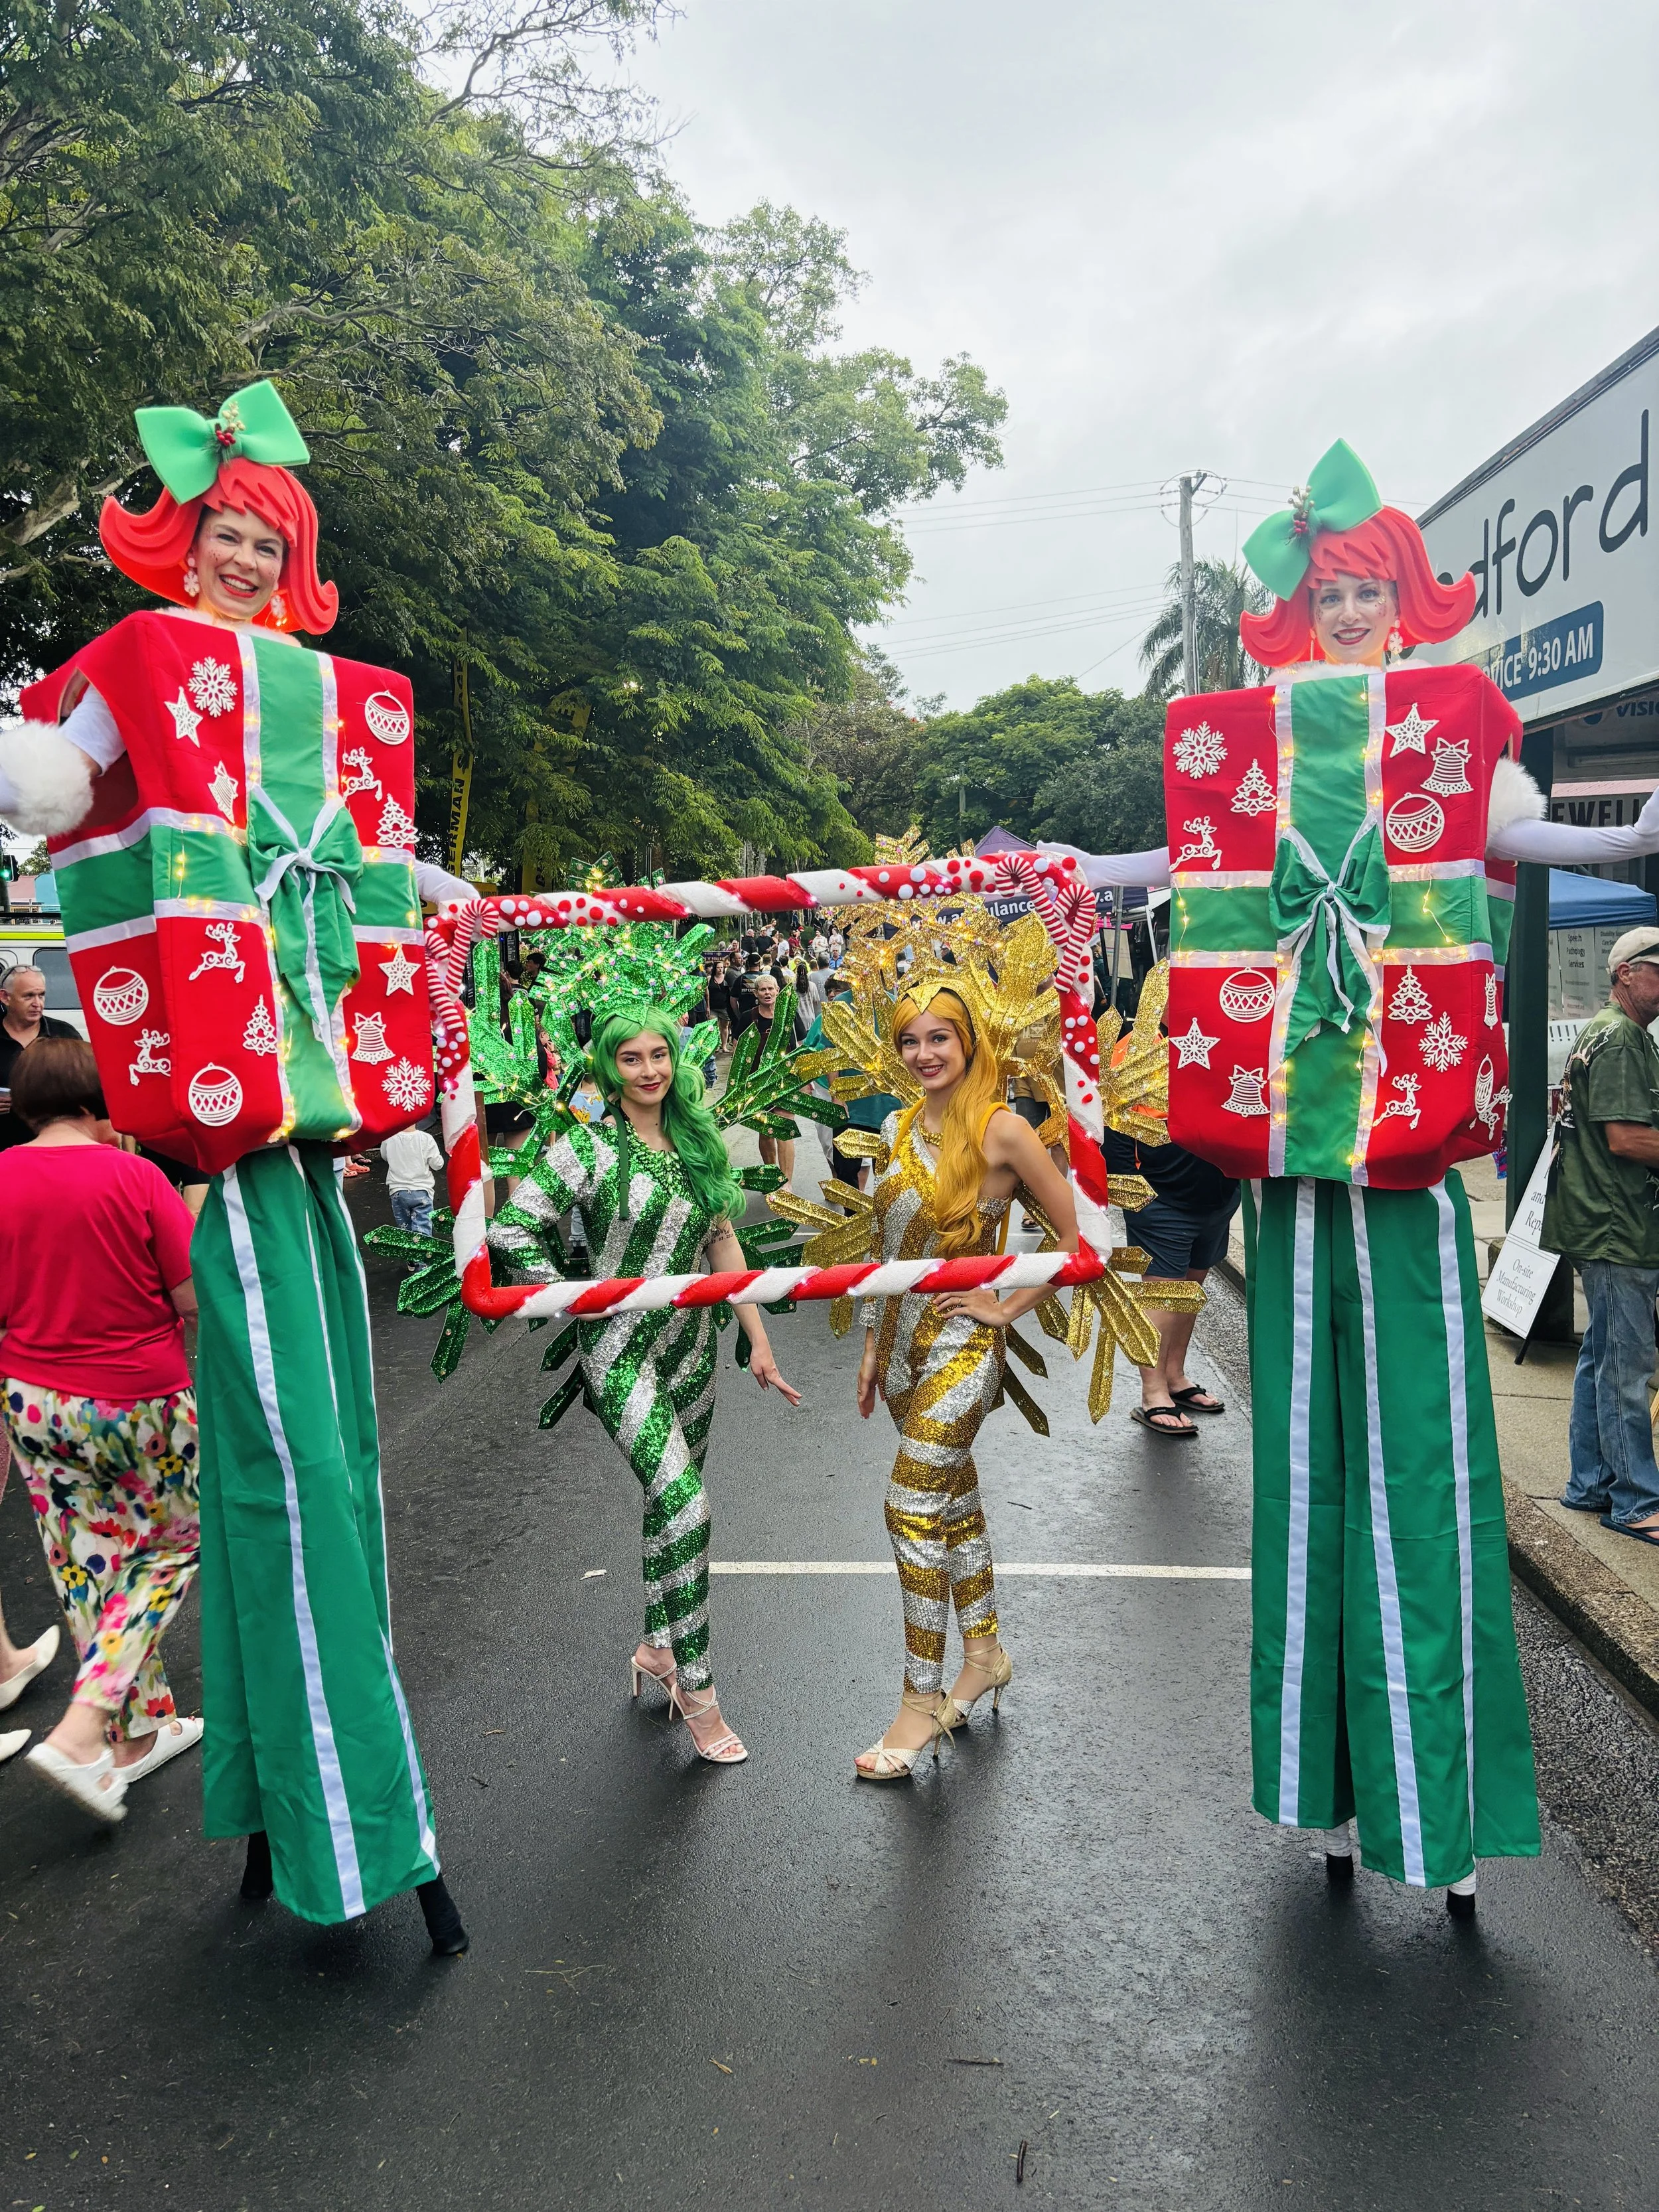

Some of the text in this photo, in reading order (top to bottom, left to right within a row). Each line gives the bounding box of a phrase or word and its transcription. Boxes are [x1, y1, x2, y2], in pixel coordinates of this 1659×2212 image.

[1435, 409, 1649, 627] dford
[1482, 623, 1593, 690] VICE 9:30 AM
[447, 778, 465, 875] GERMAN
[1551, 798, 1640, 827] EWELL
[1512, 1258, 1534, 1279] On-site
[1496, 1270, 1536, 1305] Manufacturing
[1496, 1288, 1523, 1318] Workshop
